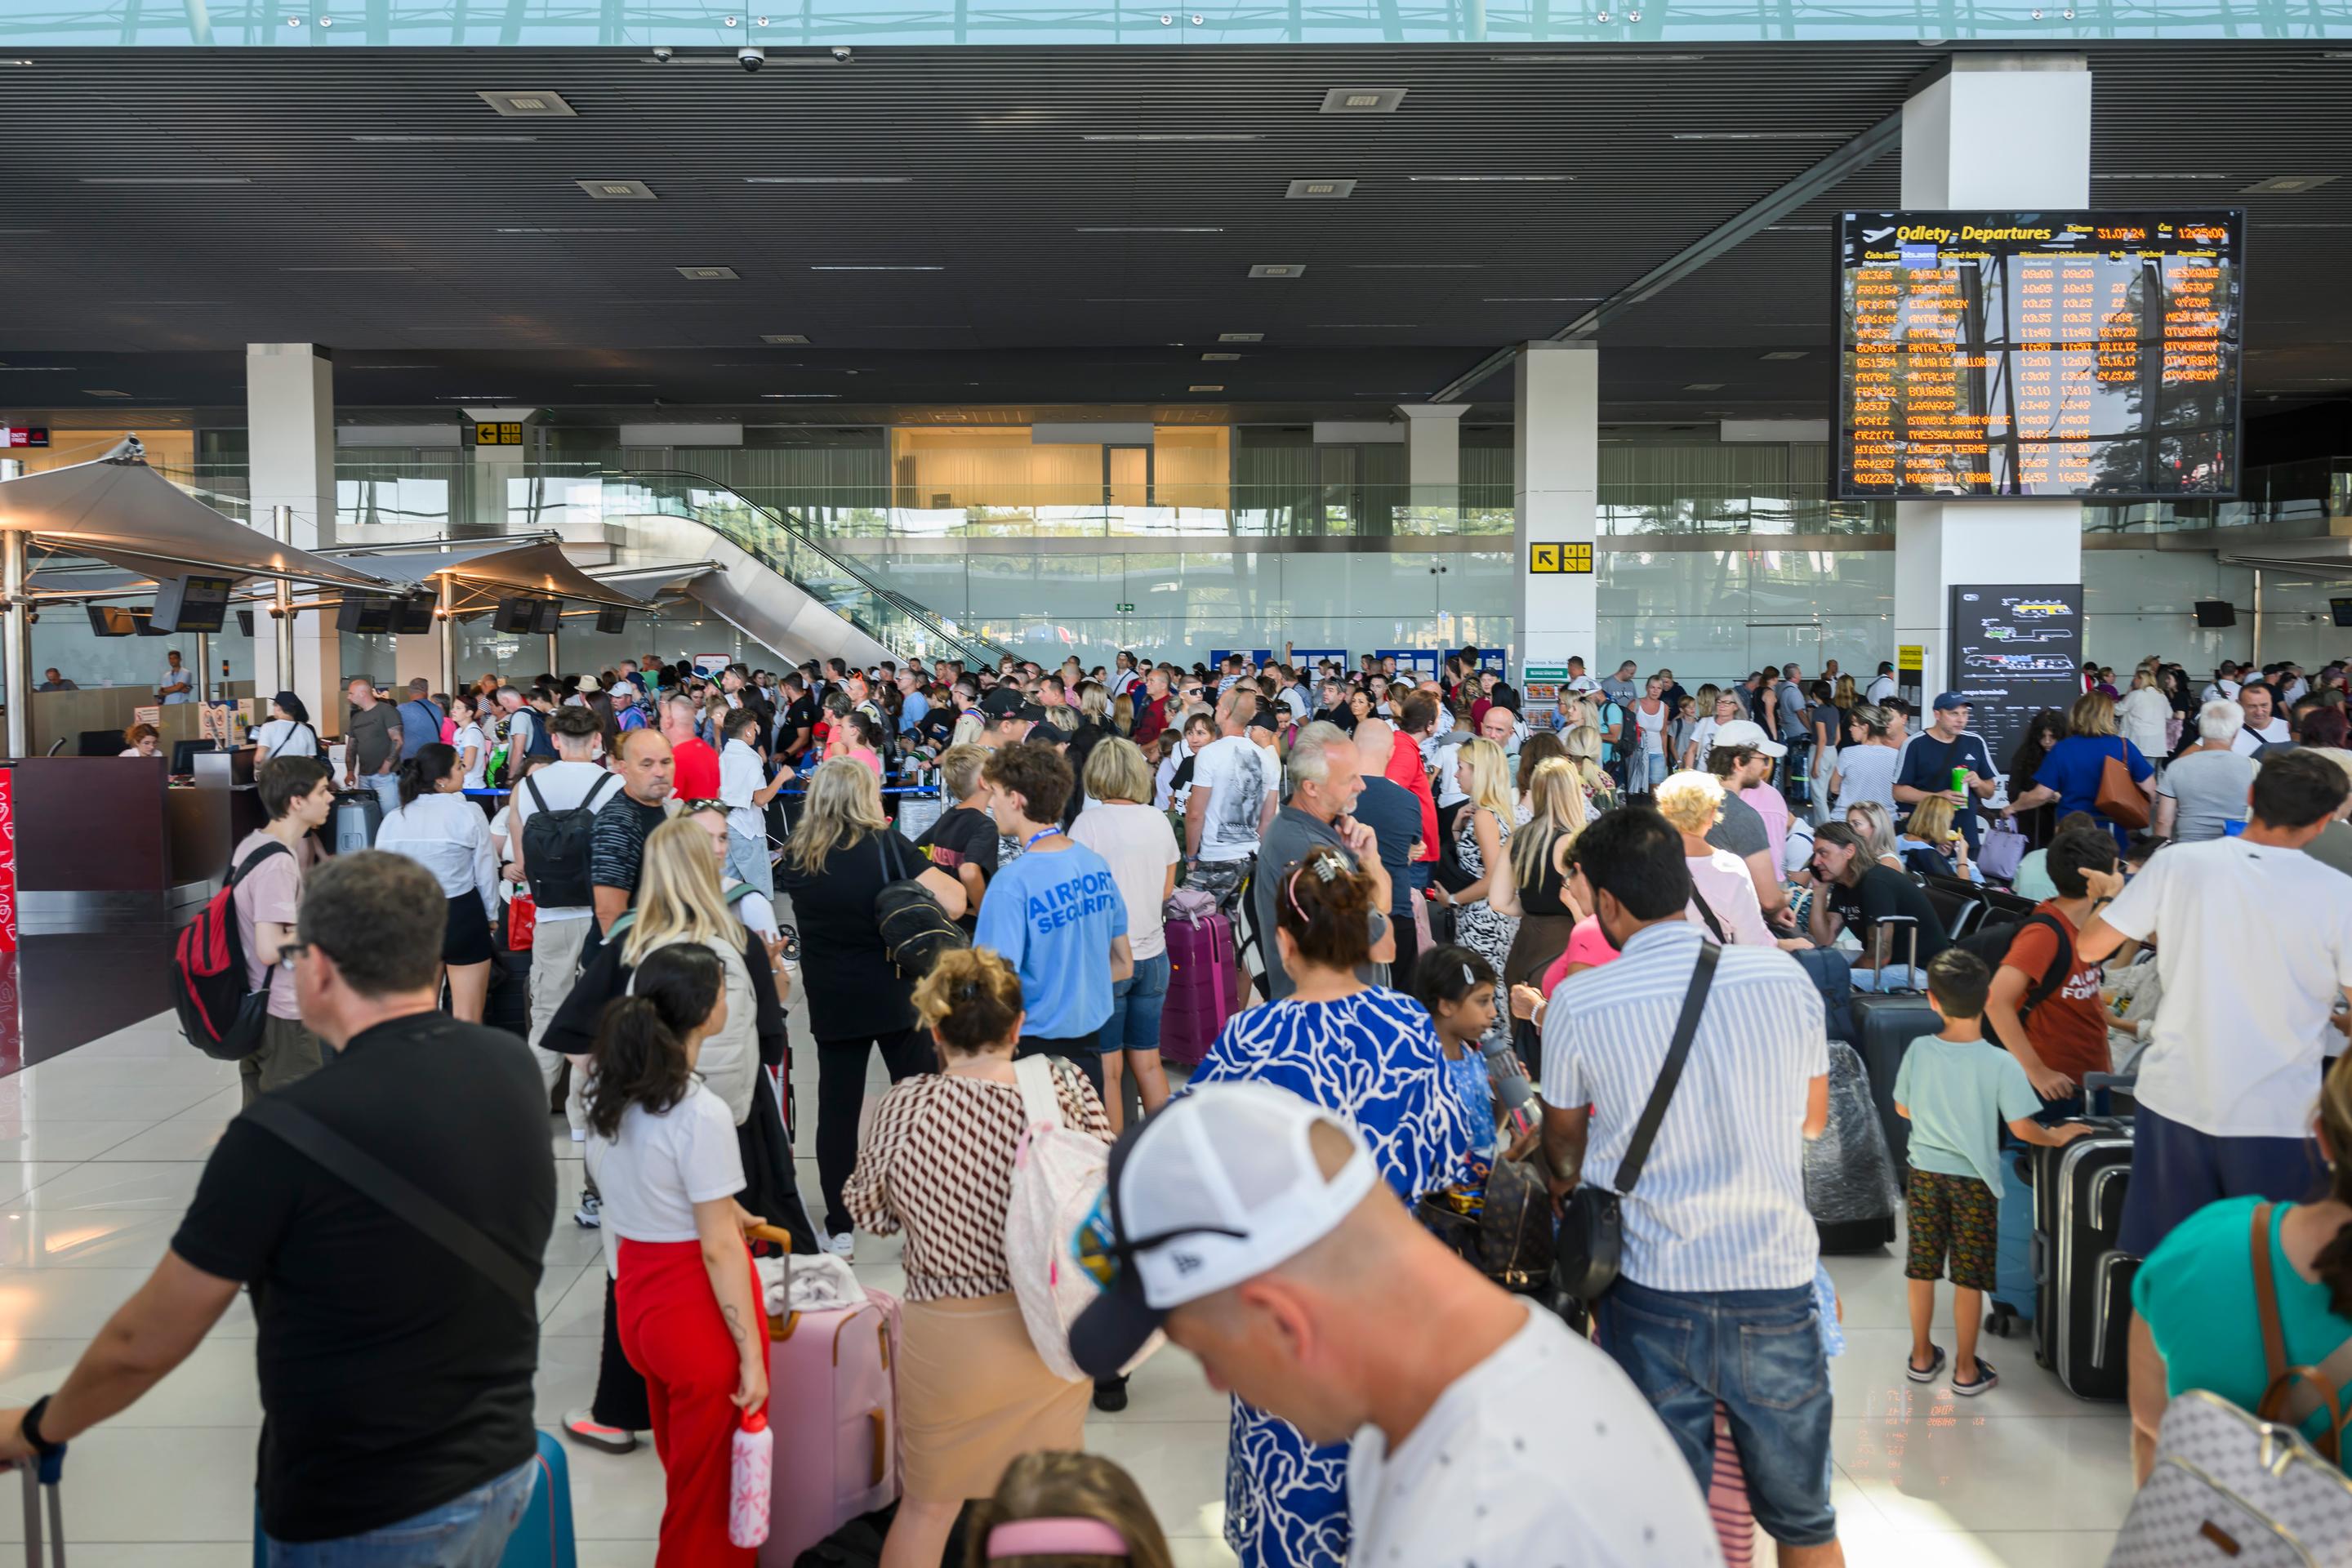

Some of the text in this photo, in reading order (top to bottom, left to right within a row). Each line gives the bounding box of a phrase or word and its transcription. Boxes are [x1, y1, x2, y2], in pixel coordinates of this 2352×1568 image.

[1896, 225, 1951, 243] Odlety
[1961, 225, 2051, 243] Departures
[2097, 227, 2146, 239] 31.07.24
[2178, 228, 2225, 239] 12:25:00
[1908, 328, 1956, 338] ANTALYA
[1908, 343, 1957, 353] ANTALYA
[1908, 358, 1937, 368] PALMA
[1940, 358, 1951, 368] DE
[1953, 358, 1997, 368] MALLORCA
[2020, 356, 2051, 367] 12:00
[2060, 356, 2091, 367] 12:00
[2098, 356, 2136, 367] 15,16,17
[1908, 387, 1956, 397] BOURGAS
[2020, 385, 2051, 396] 13:10
[2060, 385, 2091, 396] 13:10
[1908, 430, 1984, 440] THESSALONIKI
[1905, 473, 1953, 483] PODGORICA
[2058, 472, 2089, 483] 16:35
